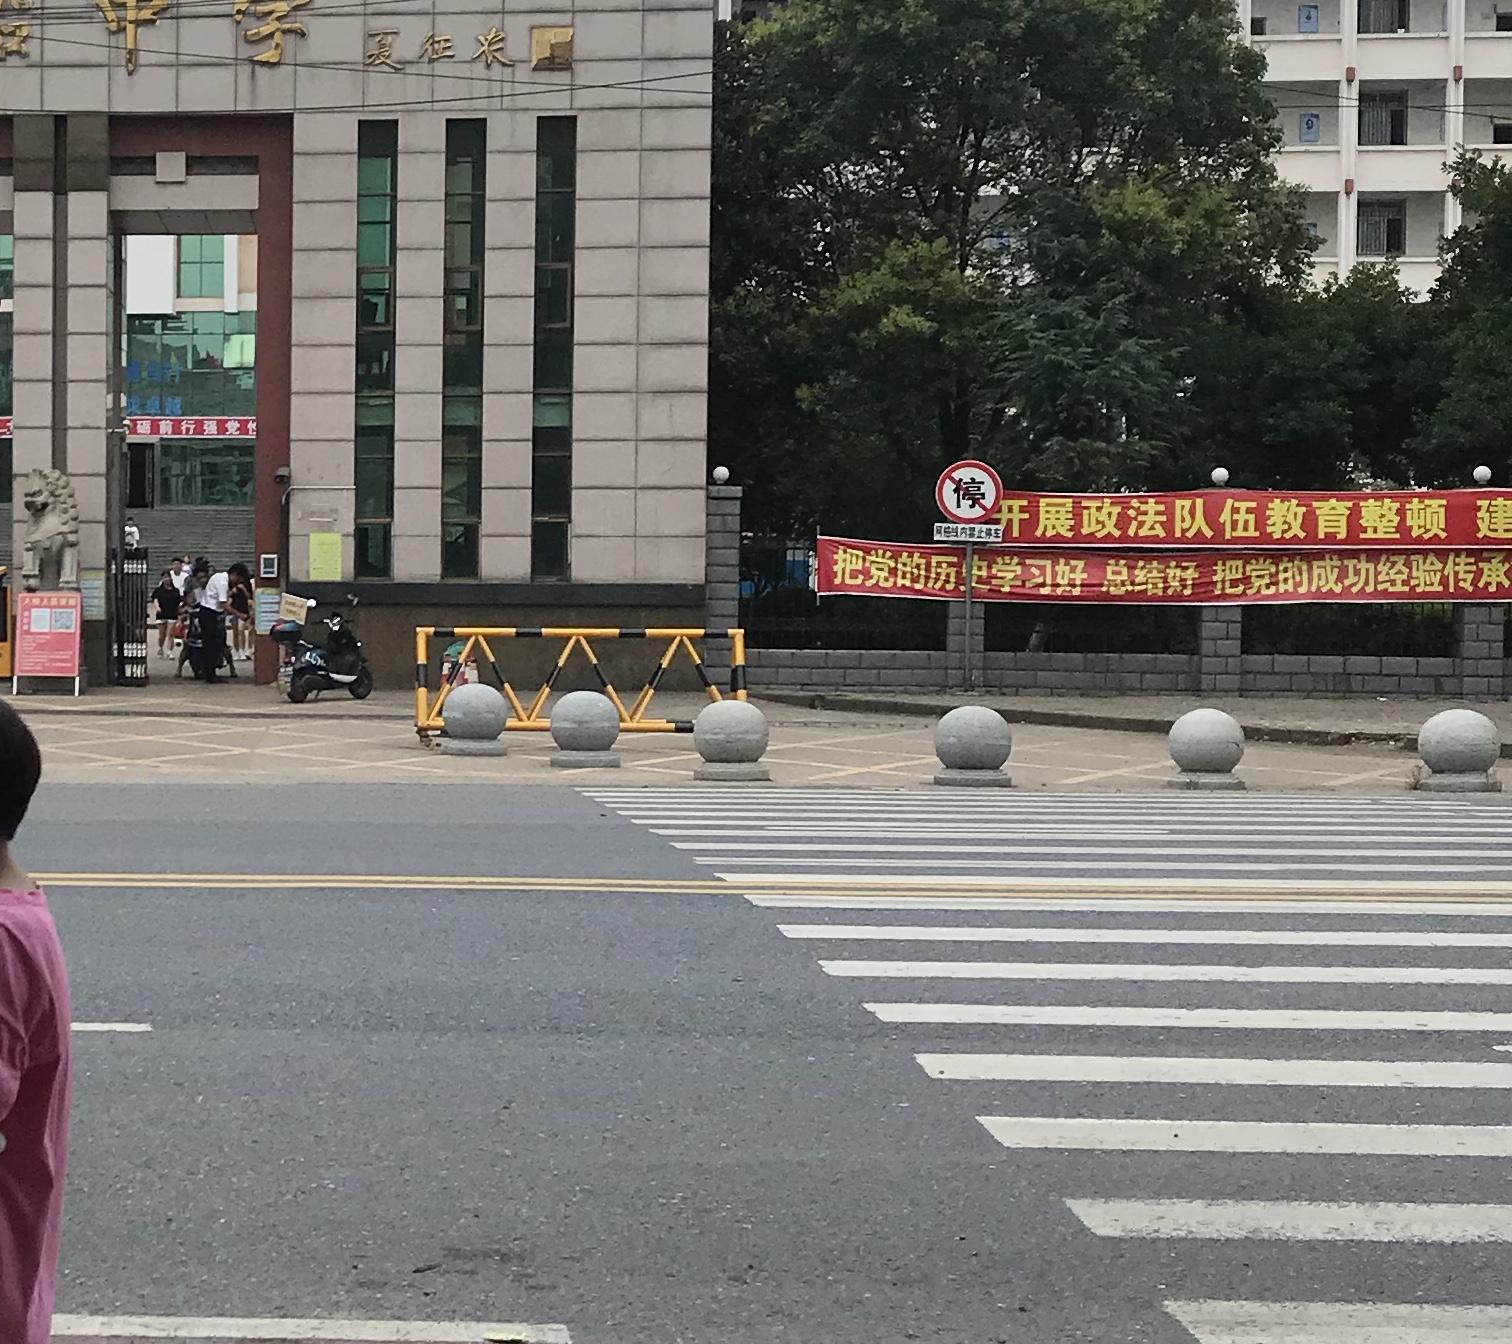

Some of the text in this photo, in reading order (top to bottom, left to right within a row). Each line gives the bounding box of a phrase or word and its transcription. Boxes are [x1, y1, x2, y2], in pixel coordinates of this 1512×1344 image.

[952, 477, 986, 509] 停
[991, 497, 1512, 540] 开展政法队伍教育整顿 建
[833, 545, 1512, 596] 把党的历史学习好 总结好 把党的成功经验传承
